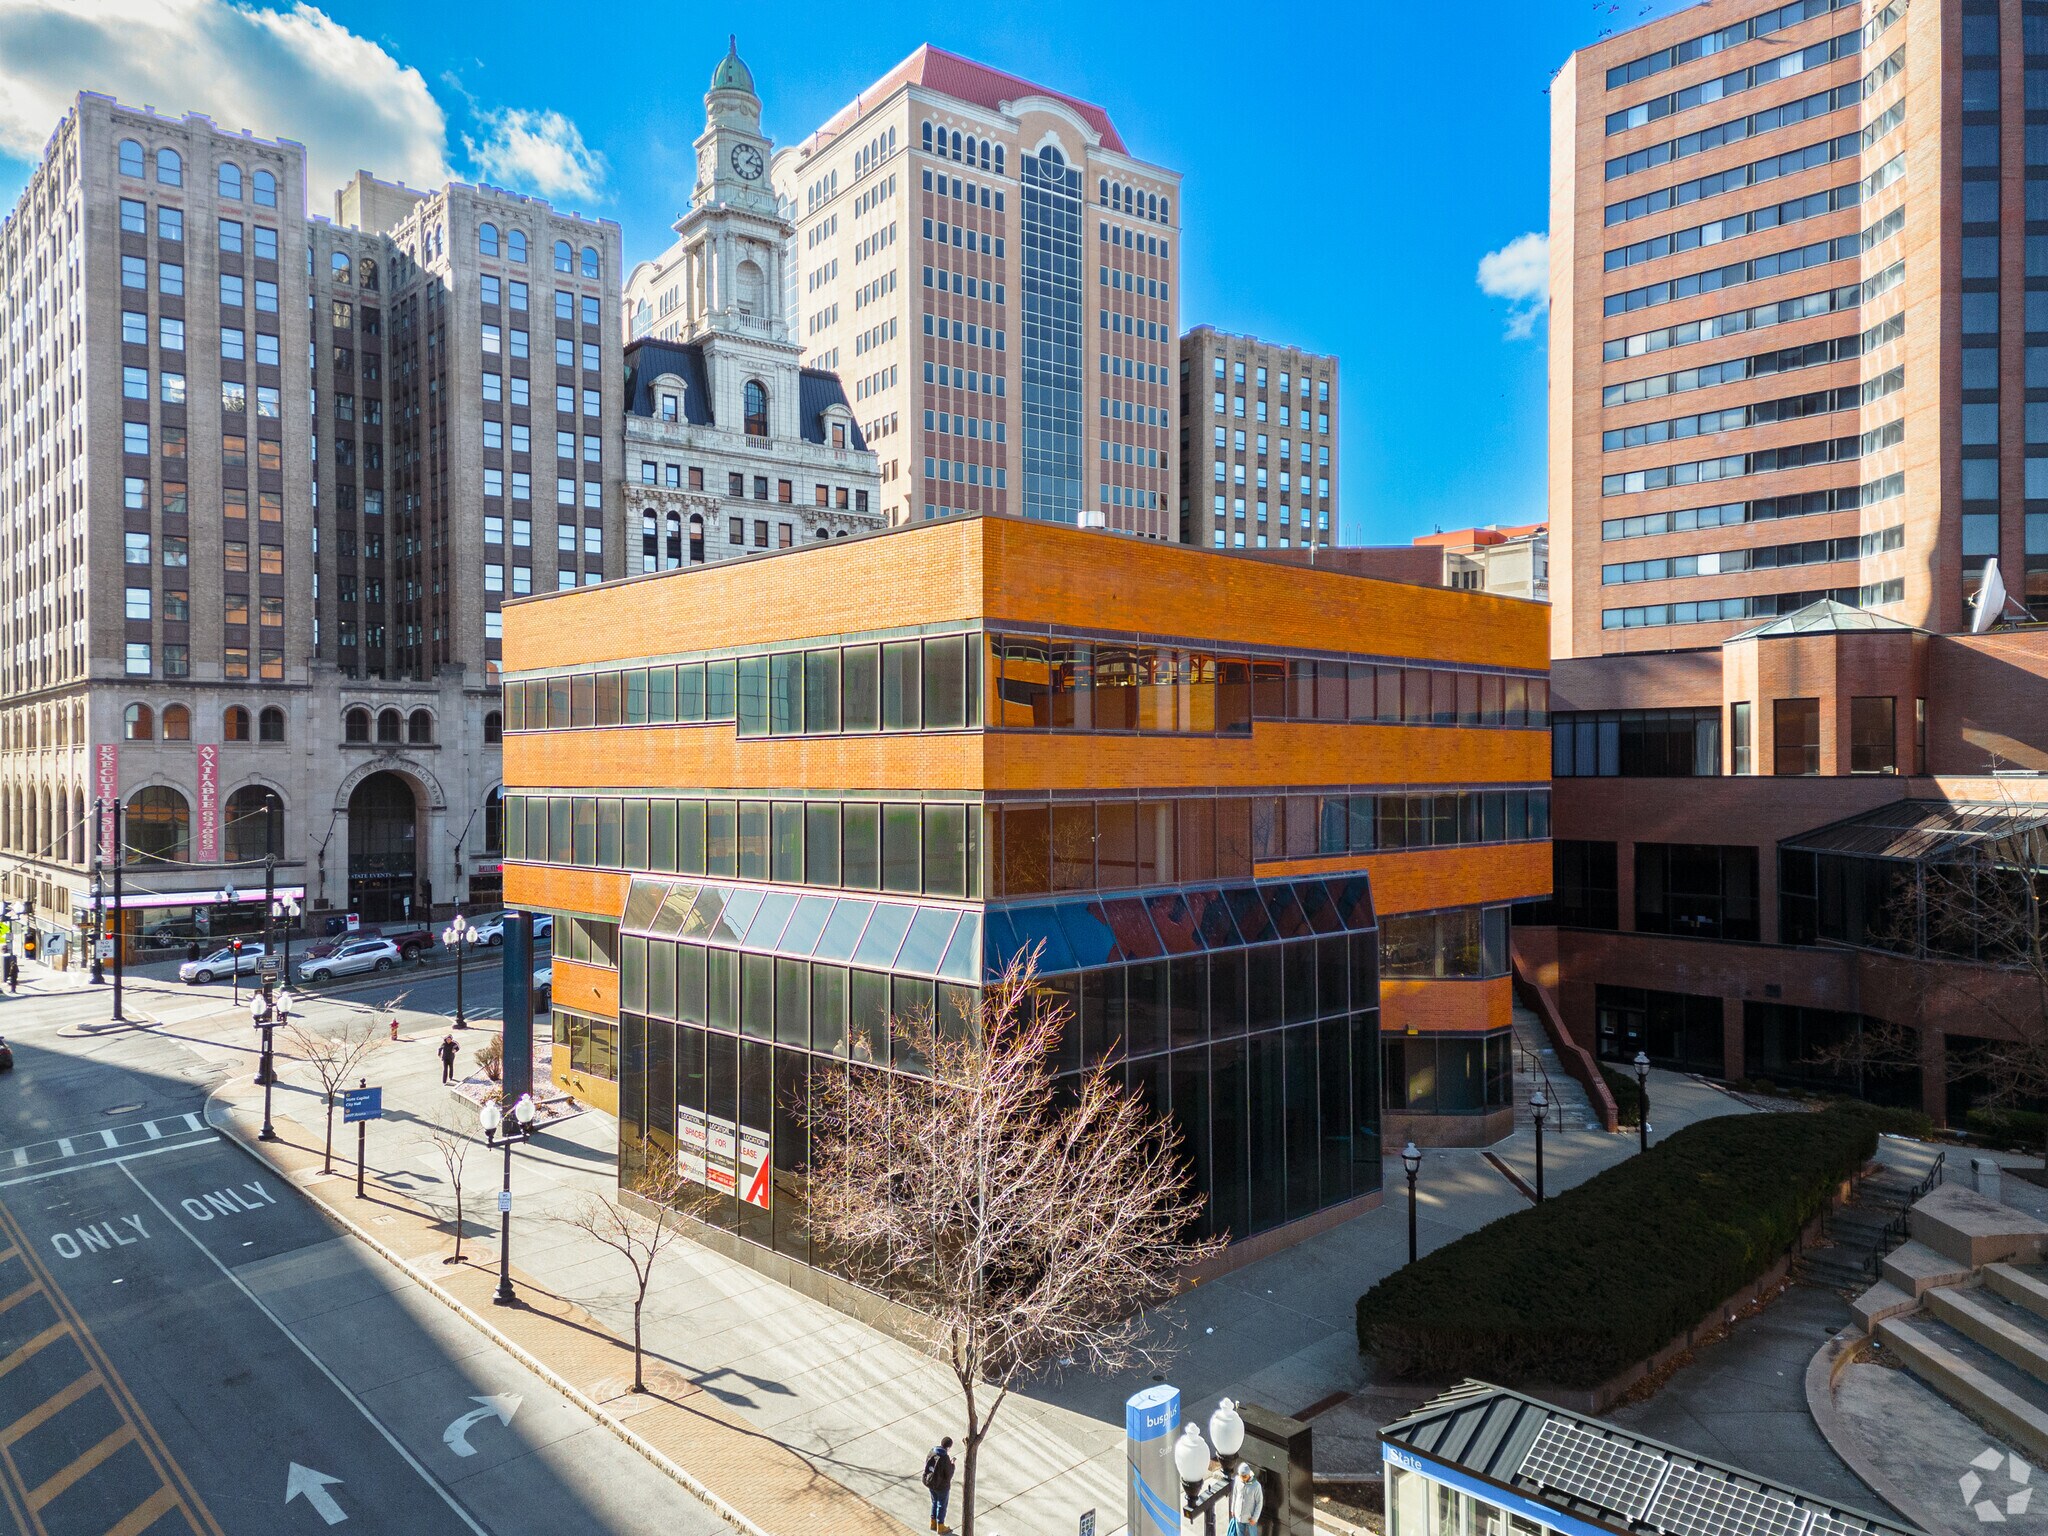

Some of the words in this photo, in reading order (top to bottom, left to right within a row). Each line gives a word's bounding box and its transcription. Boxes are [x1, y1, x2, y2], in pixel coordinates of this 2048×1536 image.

[100, 745, 115, 814] EXECUTIVE
[201, 746, 215, 808] AVAILABLE
[101, 817, 115, 863] SUITES
[684, 1126, 706, 1141] SPACES
[714, 1138, 727, 1148] FOR
[740, 1145, 758, 1159] LEASE
[180, 1181, 277, 1221] ONLY
[51, 1214, 151, 1259] ONLY
[1146, 1403, 1178, 1428] busplus
[1389, 1448, 1423, 1470] State
